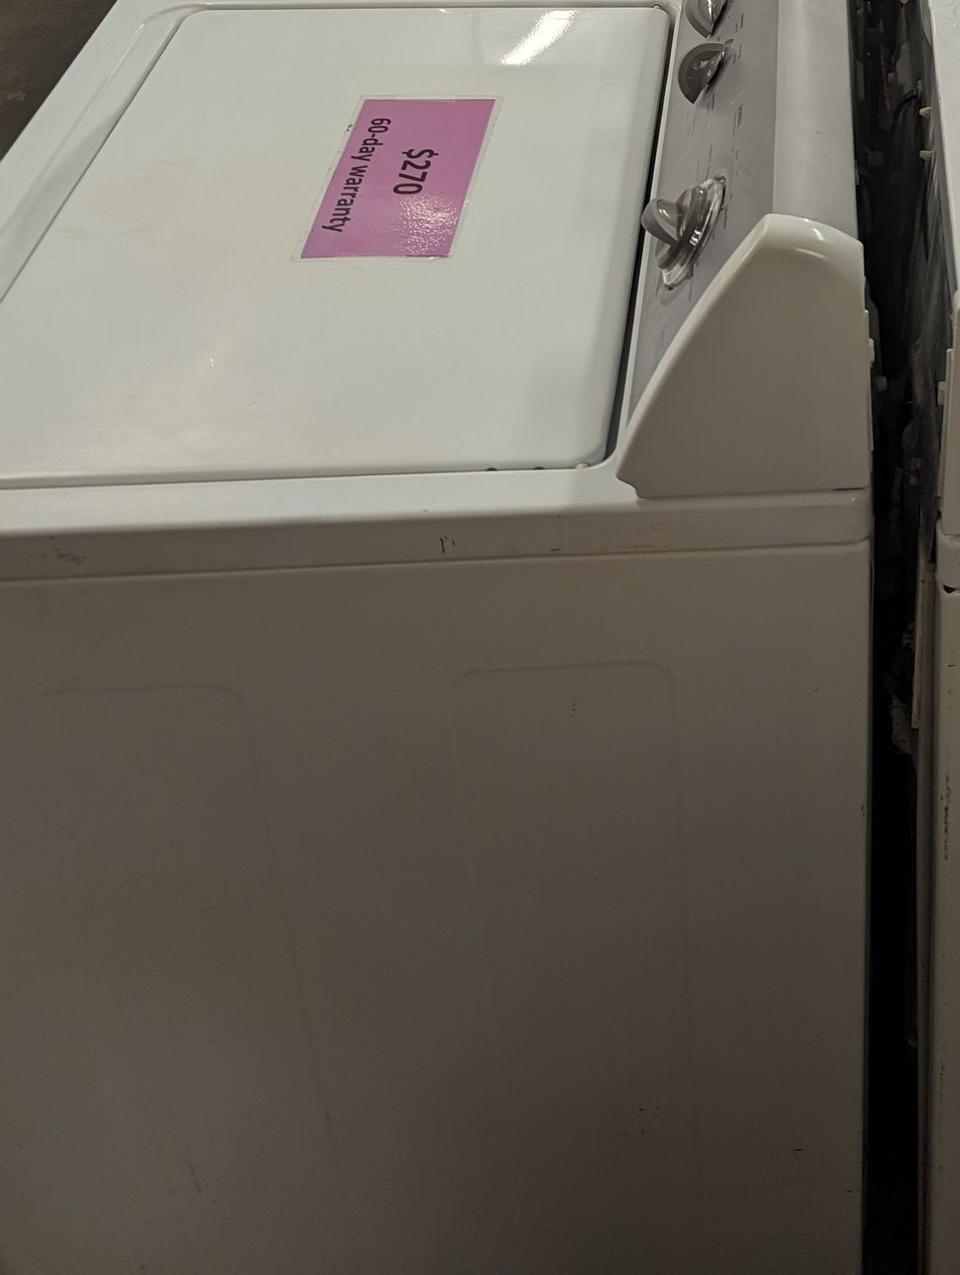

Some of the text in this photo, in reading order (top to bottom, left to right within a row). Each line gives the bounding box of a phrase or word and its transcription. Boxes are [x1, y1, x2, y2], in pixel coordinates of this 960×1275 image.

[321, 118, 392, 233] 60-day warranty
[393, 148, 439, 195] $270
